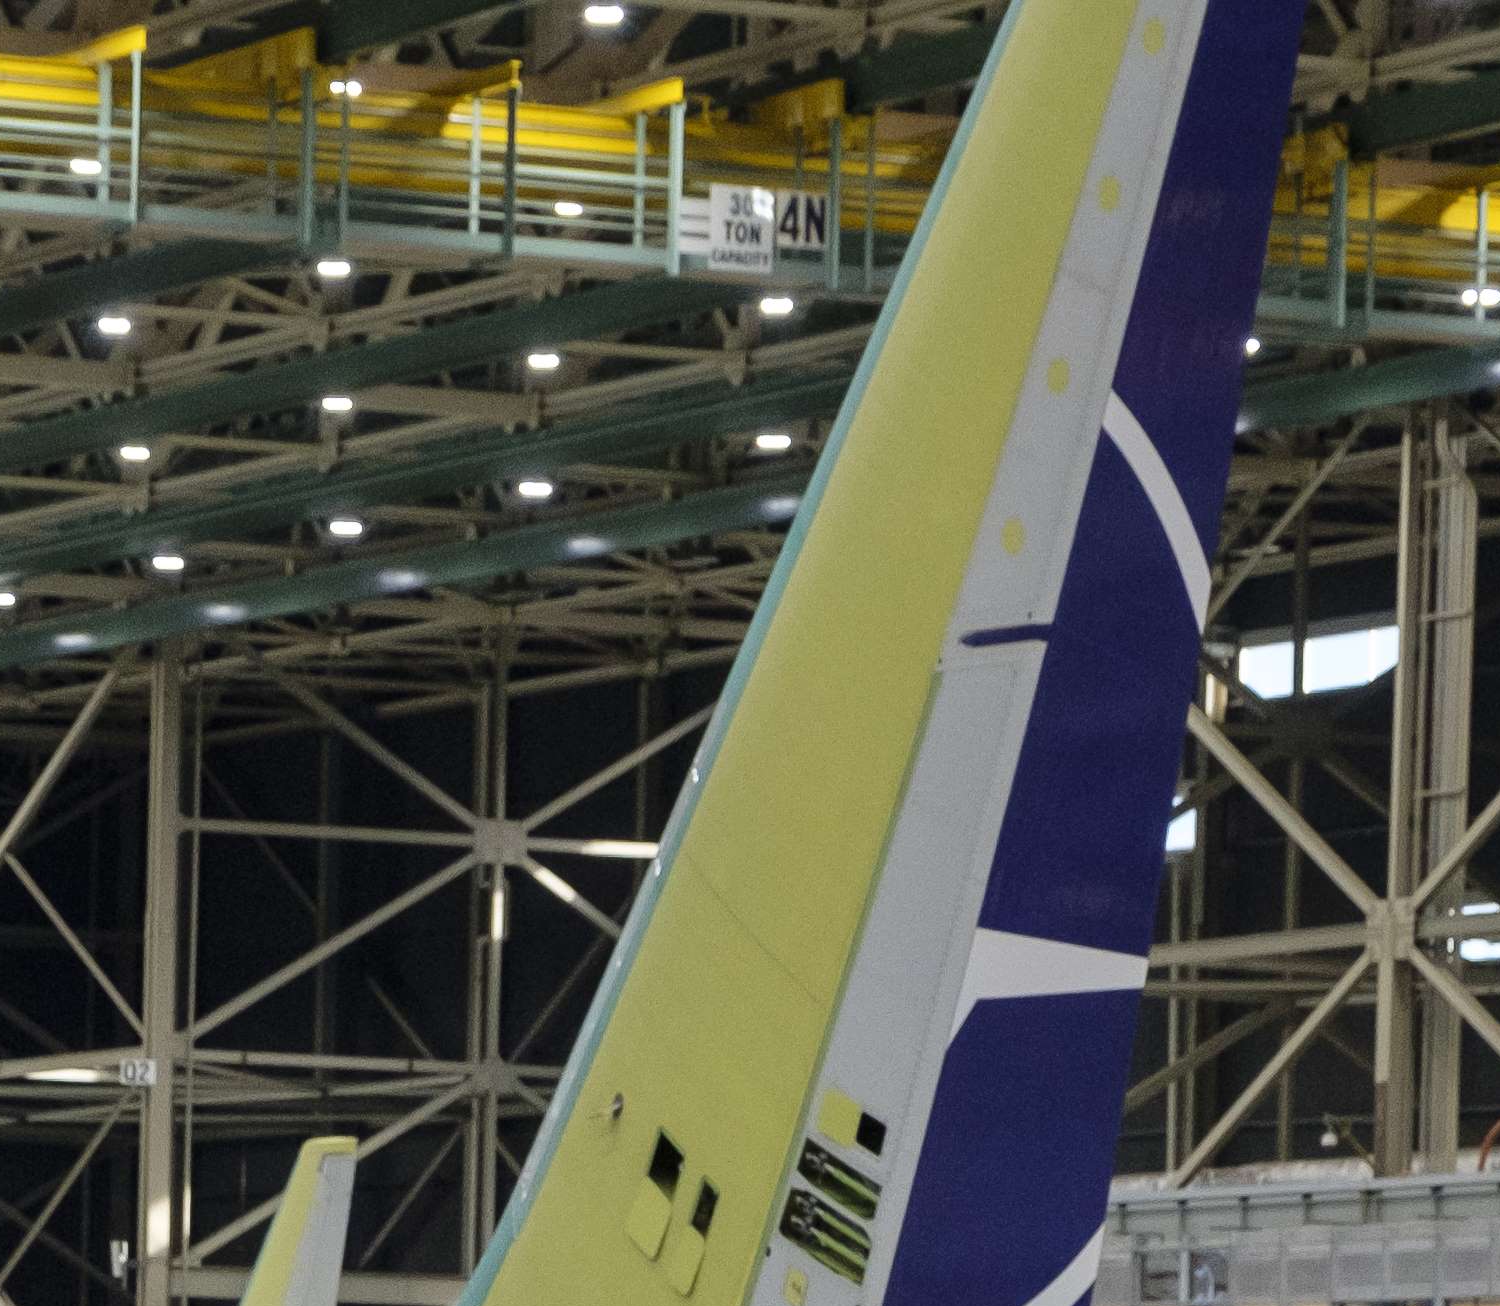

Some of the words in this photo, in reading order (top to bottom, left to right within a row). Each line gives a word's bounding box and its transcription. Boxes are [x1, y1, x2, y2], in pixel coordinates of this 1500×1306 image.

[723, 219, 763, 245] TON
[778, 195, 826, 246] 4N
[711, 248, 770, 267] CAPACITY
